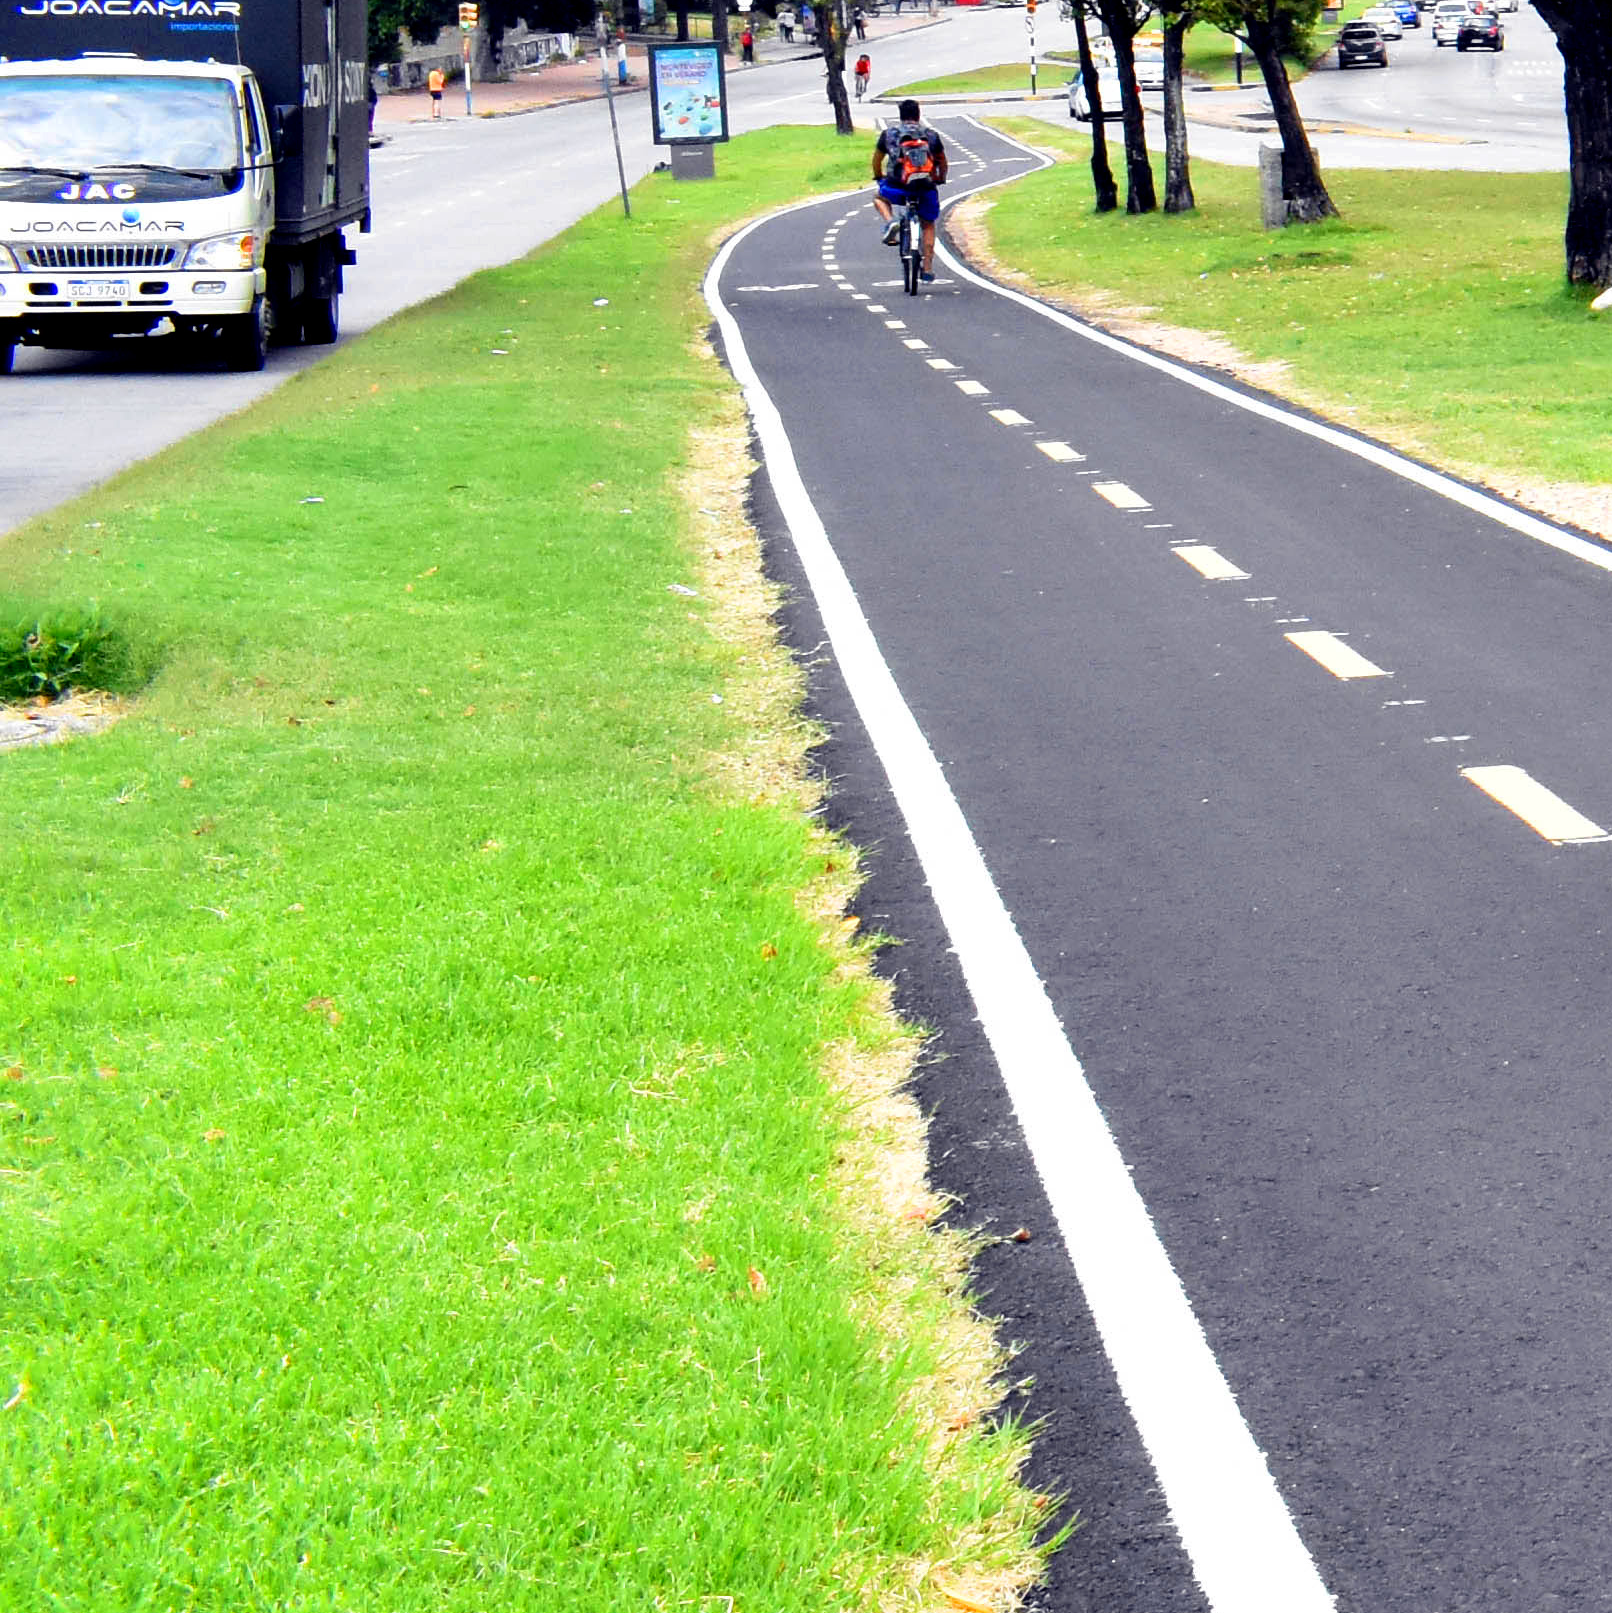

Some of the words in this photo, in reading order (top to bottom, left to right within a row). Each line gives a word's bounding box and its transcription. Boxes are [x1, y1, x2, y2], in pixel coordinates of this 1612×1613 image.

[19, 0, 241, 18] JOACAMAR
[61, 184, 136, 200] JAC
[10, 221, 185, 234] JOACAMAR
